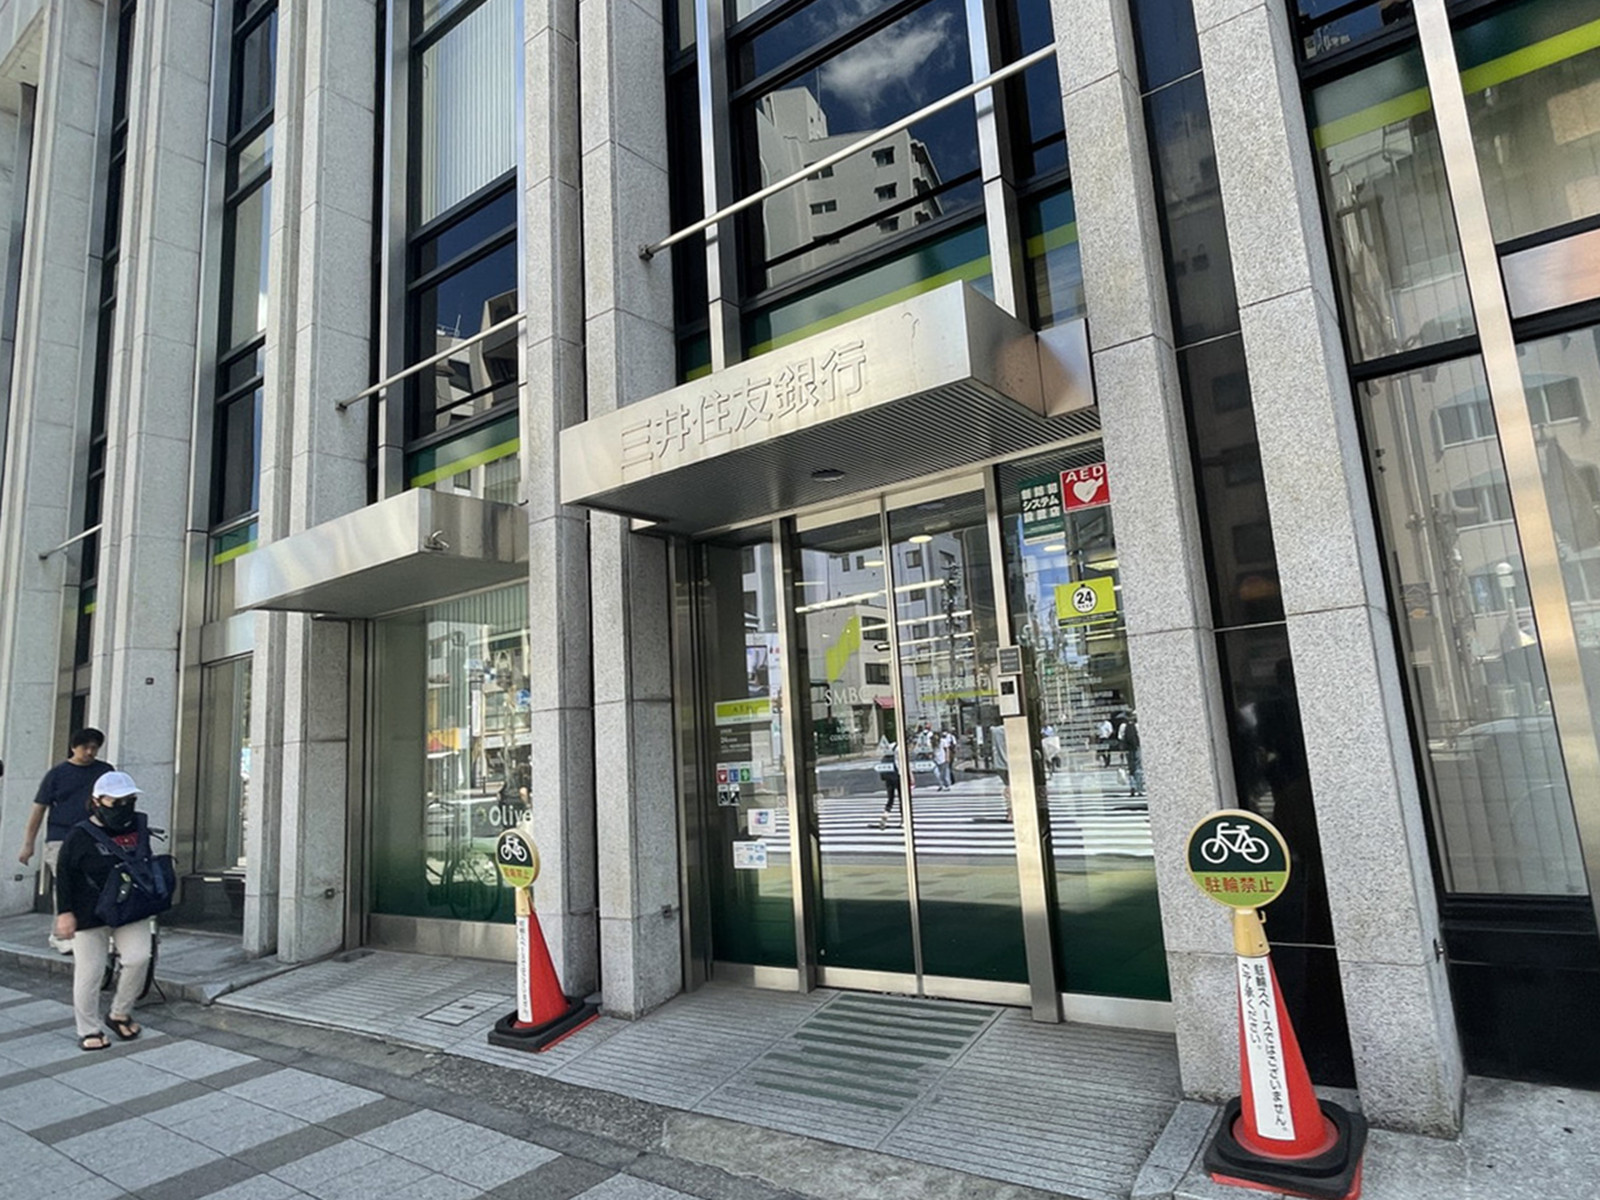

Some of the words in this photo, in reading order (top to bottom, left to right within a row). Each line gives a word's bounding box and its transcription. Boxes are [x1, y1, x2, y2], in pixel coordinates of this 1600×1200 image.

[621, 339, 868, 470] 三井住友銀行
[1065, 465, 1104, 484] AED
[1022, 494, 1060, 512] システム
[1076, 591, 1093, 604] 24
[824, 686, 874, 706] SMBC
[489, 805, 533, 827] Olive
[1205, 876, 1275, 893] 駐輪禁止
